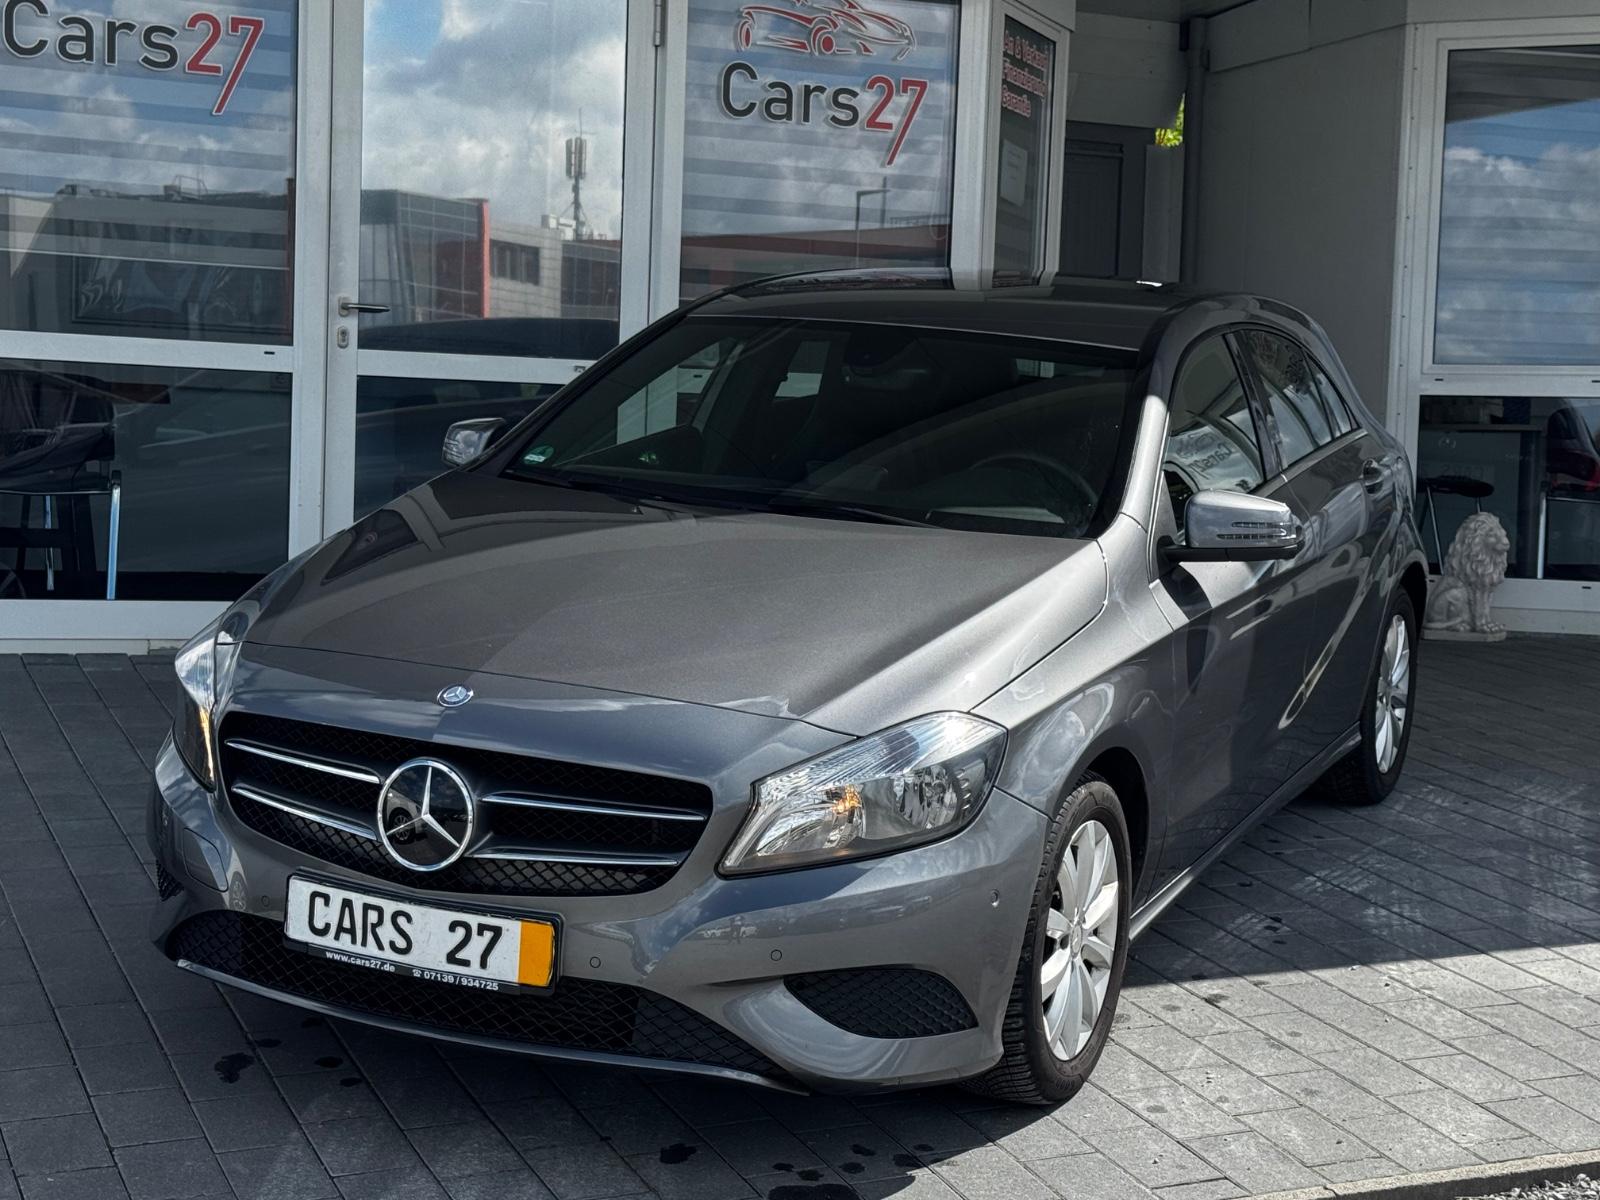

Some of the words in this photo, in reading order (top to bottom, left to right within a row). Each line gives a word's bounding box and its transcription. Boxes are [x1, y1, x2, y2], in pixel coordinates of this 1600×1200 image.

[2, 0, 264, 116] Cars27
[721, 60, 929, 167] Cars27
[308, 891, 413, 955] CARS
[446, 919, 503, 970] 27
[325, 951, 396, 973] www.cars27.de
[424, 971, 455, 984] 07139
[461, 977, 499, 991] 934725
